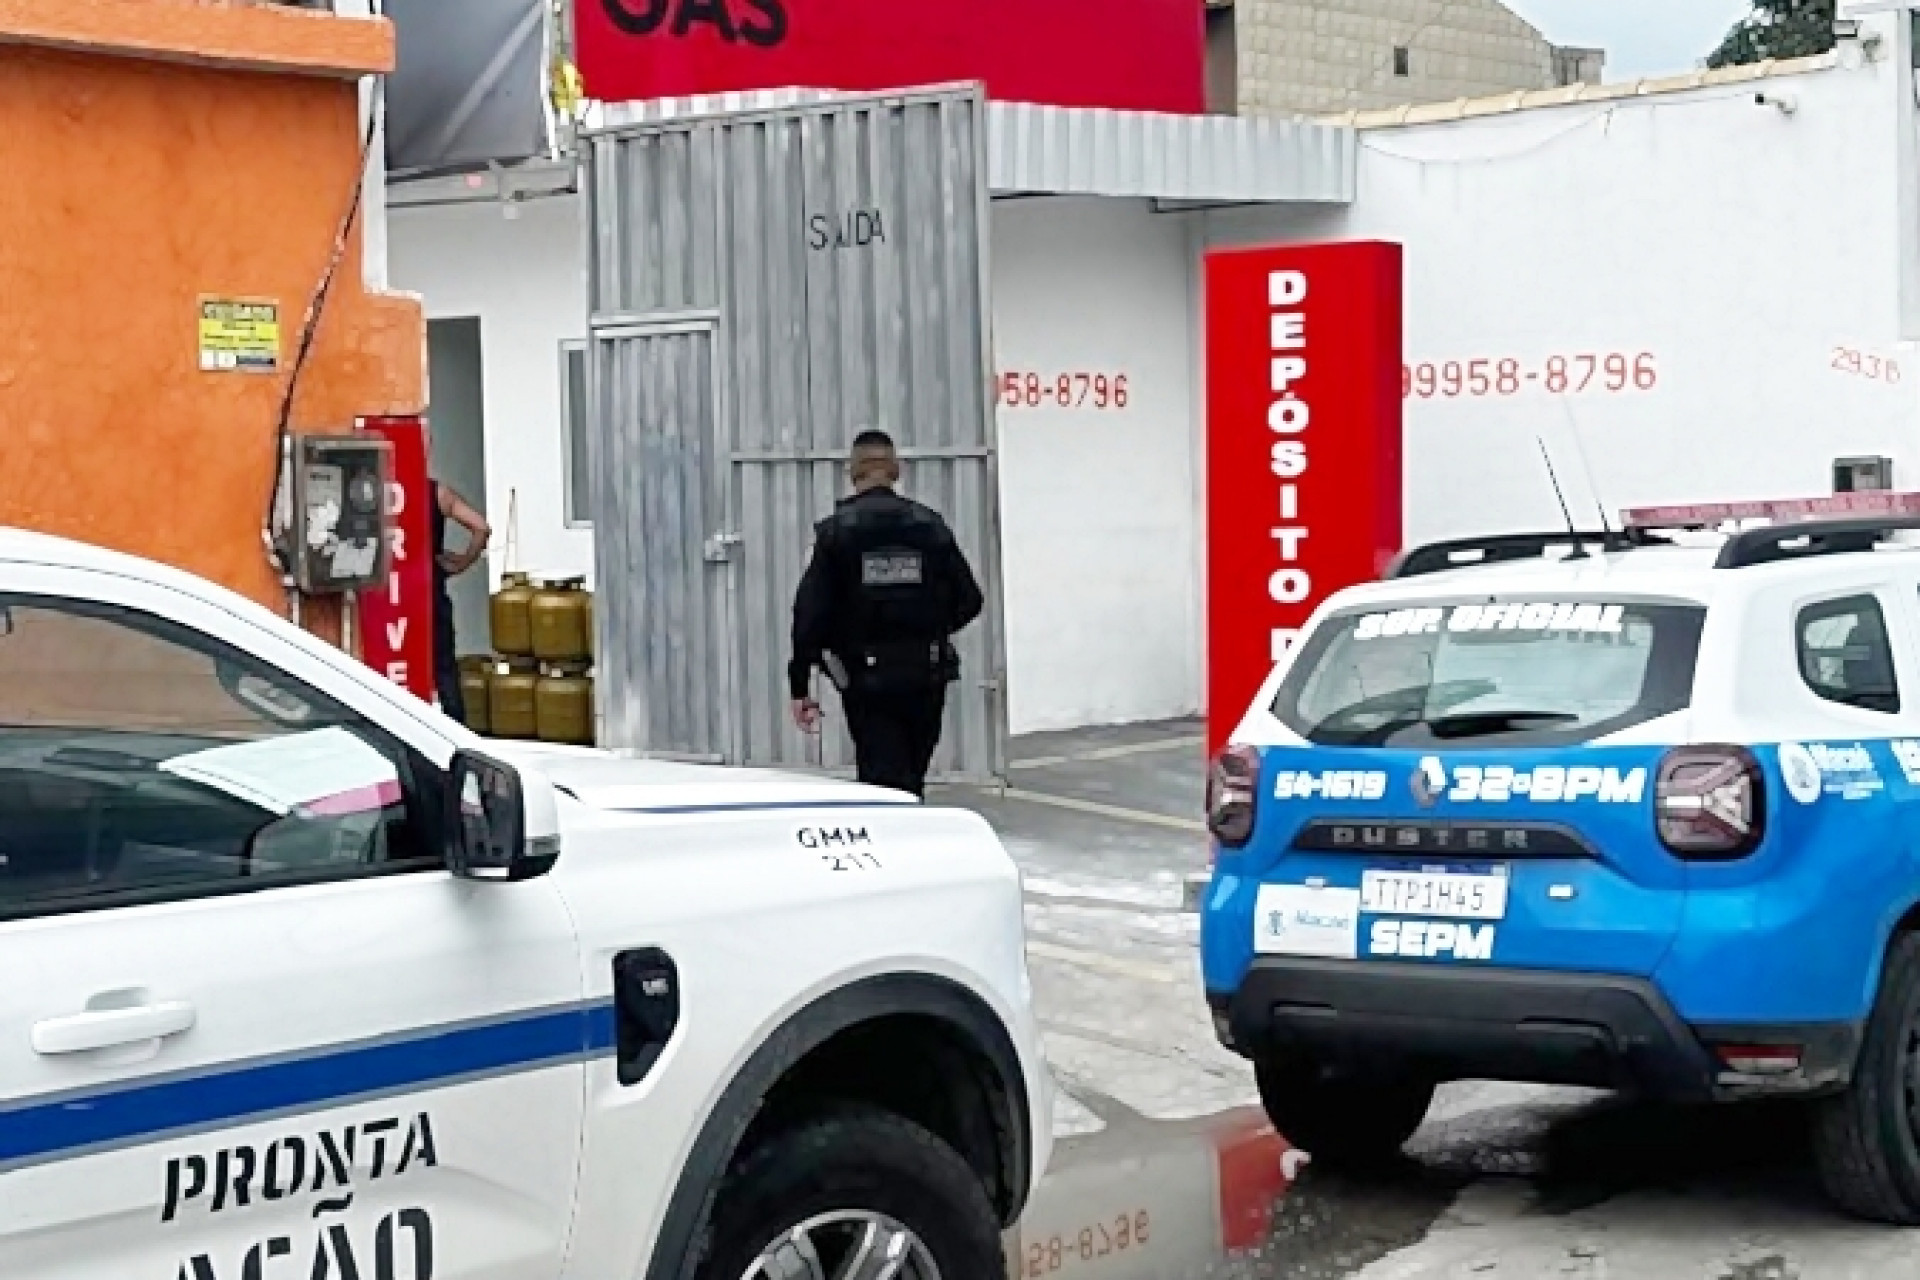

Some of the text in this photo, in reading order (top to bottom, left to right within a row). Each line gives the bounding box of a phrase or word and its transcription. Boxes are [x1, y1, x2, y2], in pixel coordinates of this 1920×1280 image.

[1267, 269, 1310, 604] DEPÓSITO
[1448, 602, 1624, 631] OFICIAL
[796, 827, 873, 848] GMM
[1333, 827, 1528, 847] DUSTER
[1370, 922, 1494, 959] SEPM
[161, 1111, 438, 1223] PRONTA
[177, 1192, 433, 1280] ÃO
